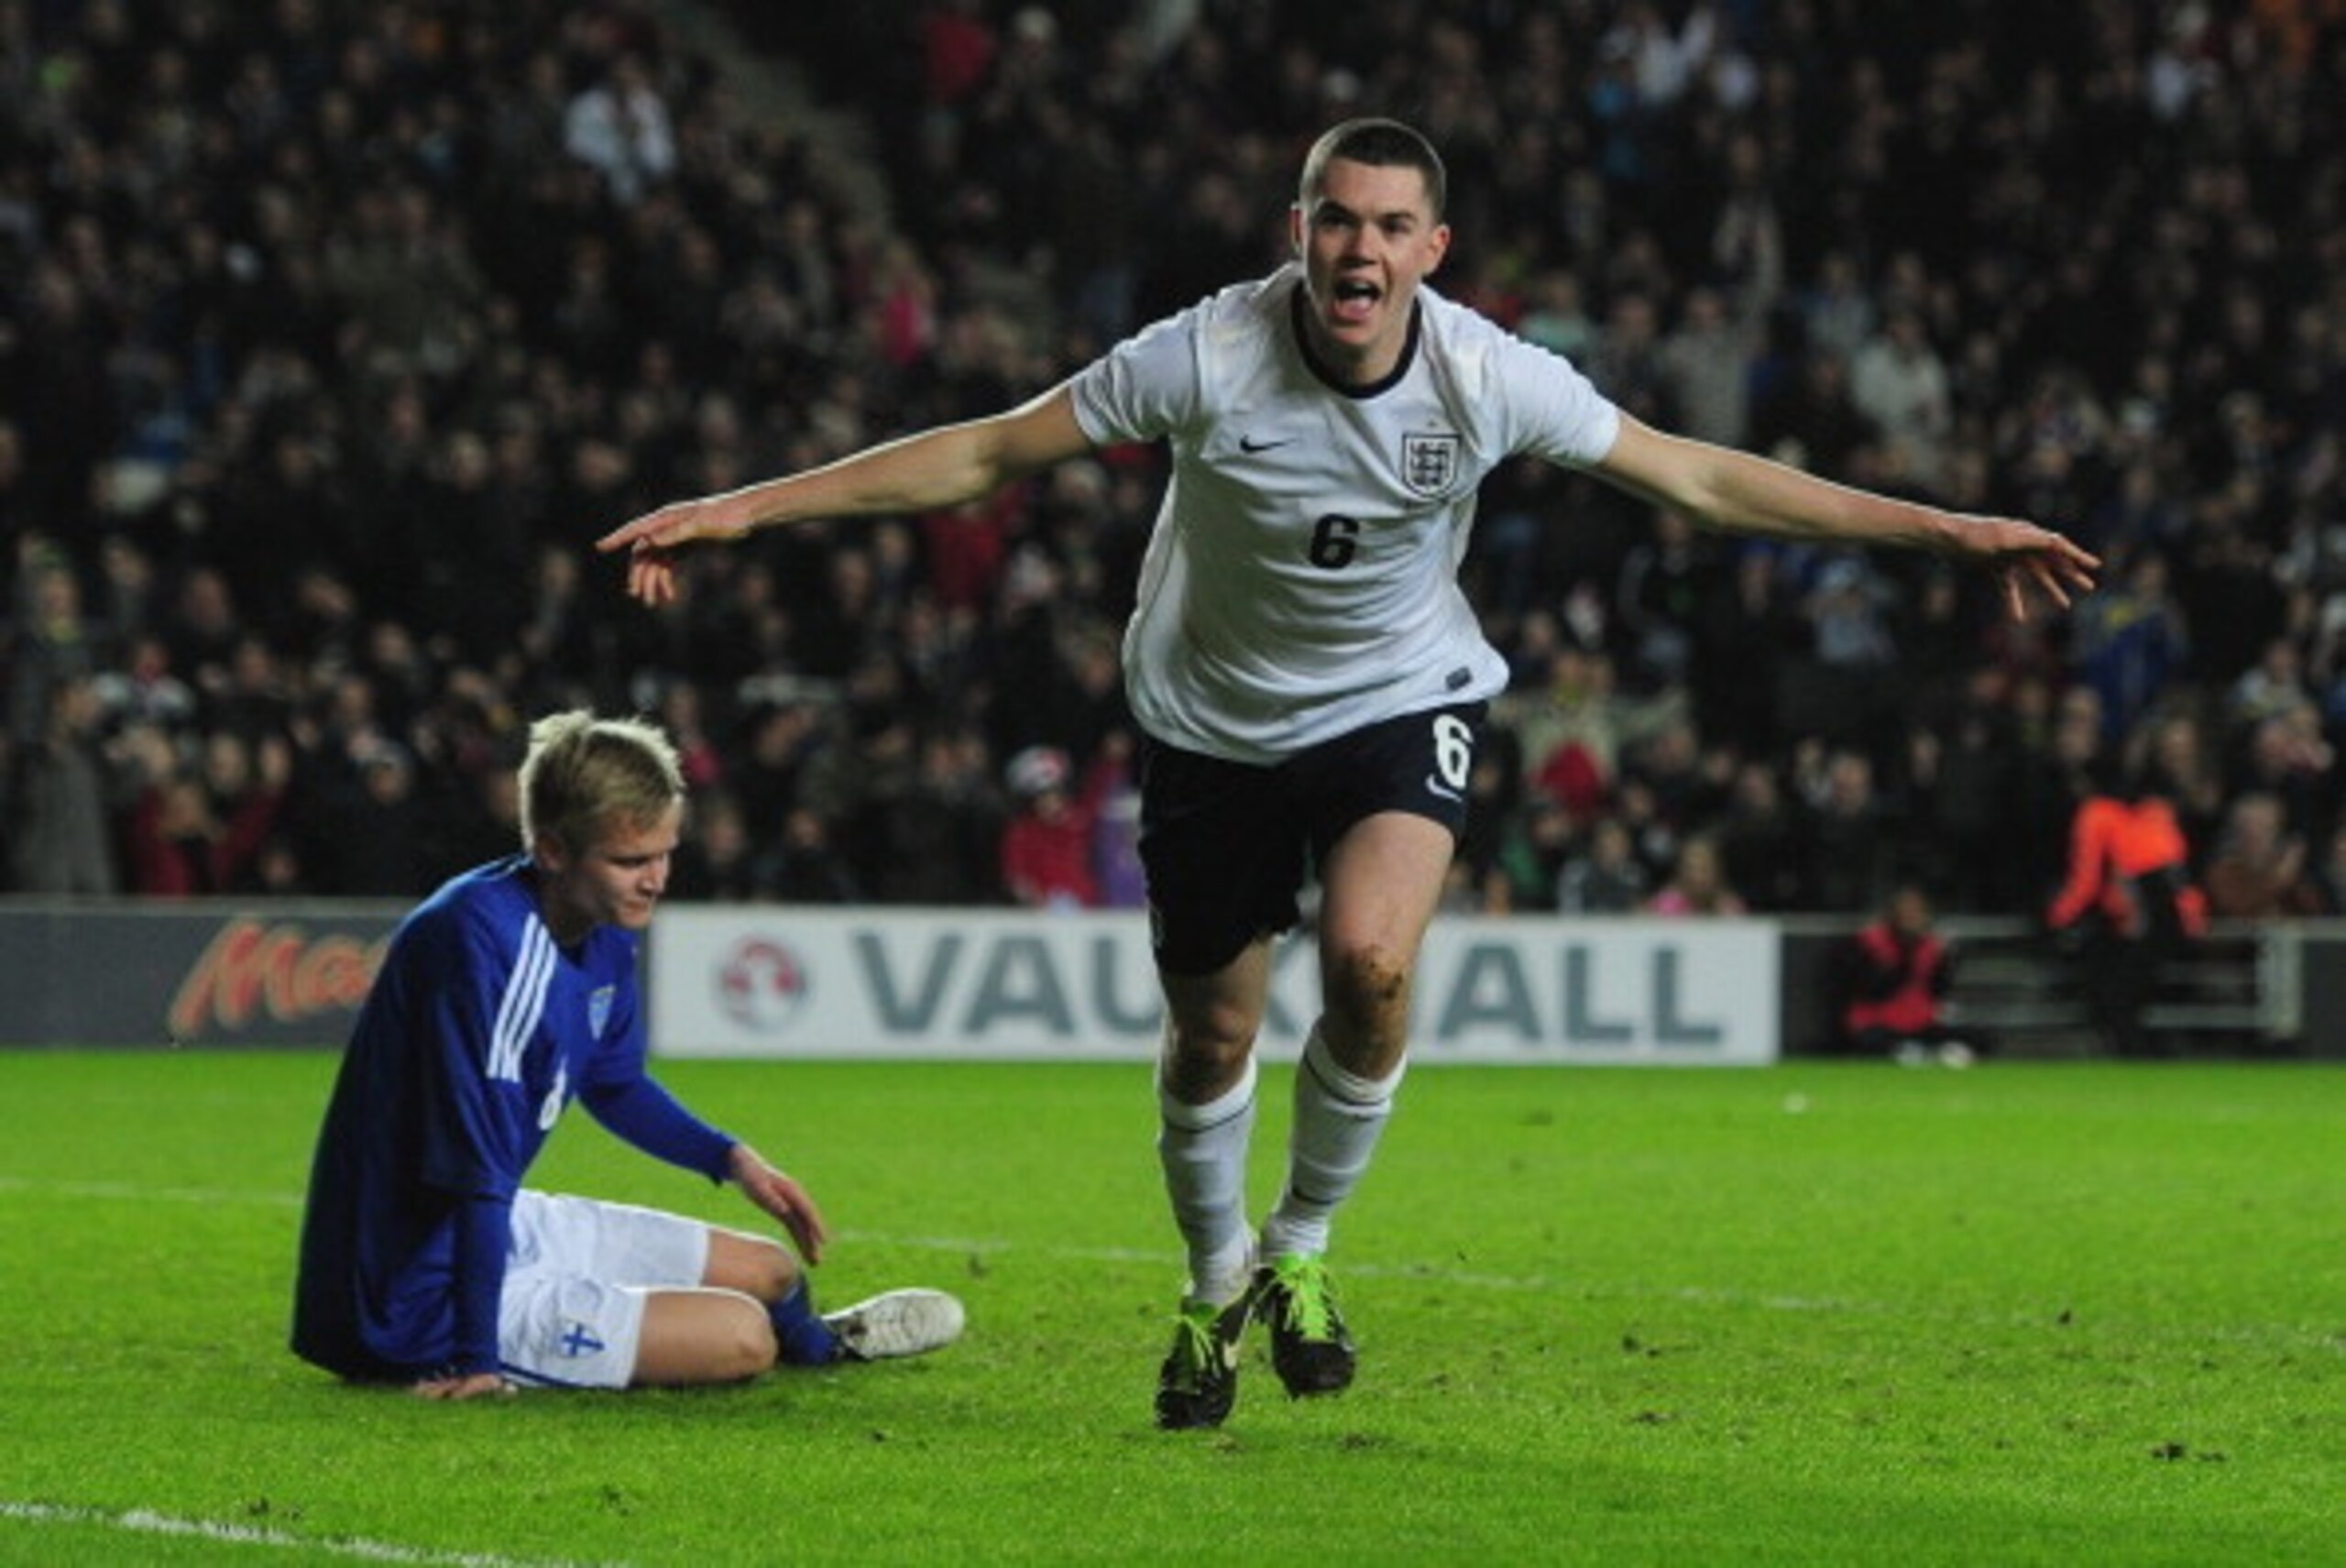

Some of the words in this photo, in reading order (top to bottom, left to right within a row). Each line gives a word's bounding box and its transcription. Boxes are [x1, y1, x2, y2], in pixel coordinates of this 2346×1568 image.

[1309, 512, 1360, 570] 6
[1432, 713, 1474, 789] 6
[168, 916, 390, 1037] Ma
[852, 931, 1725, 1045] VAUALL
